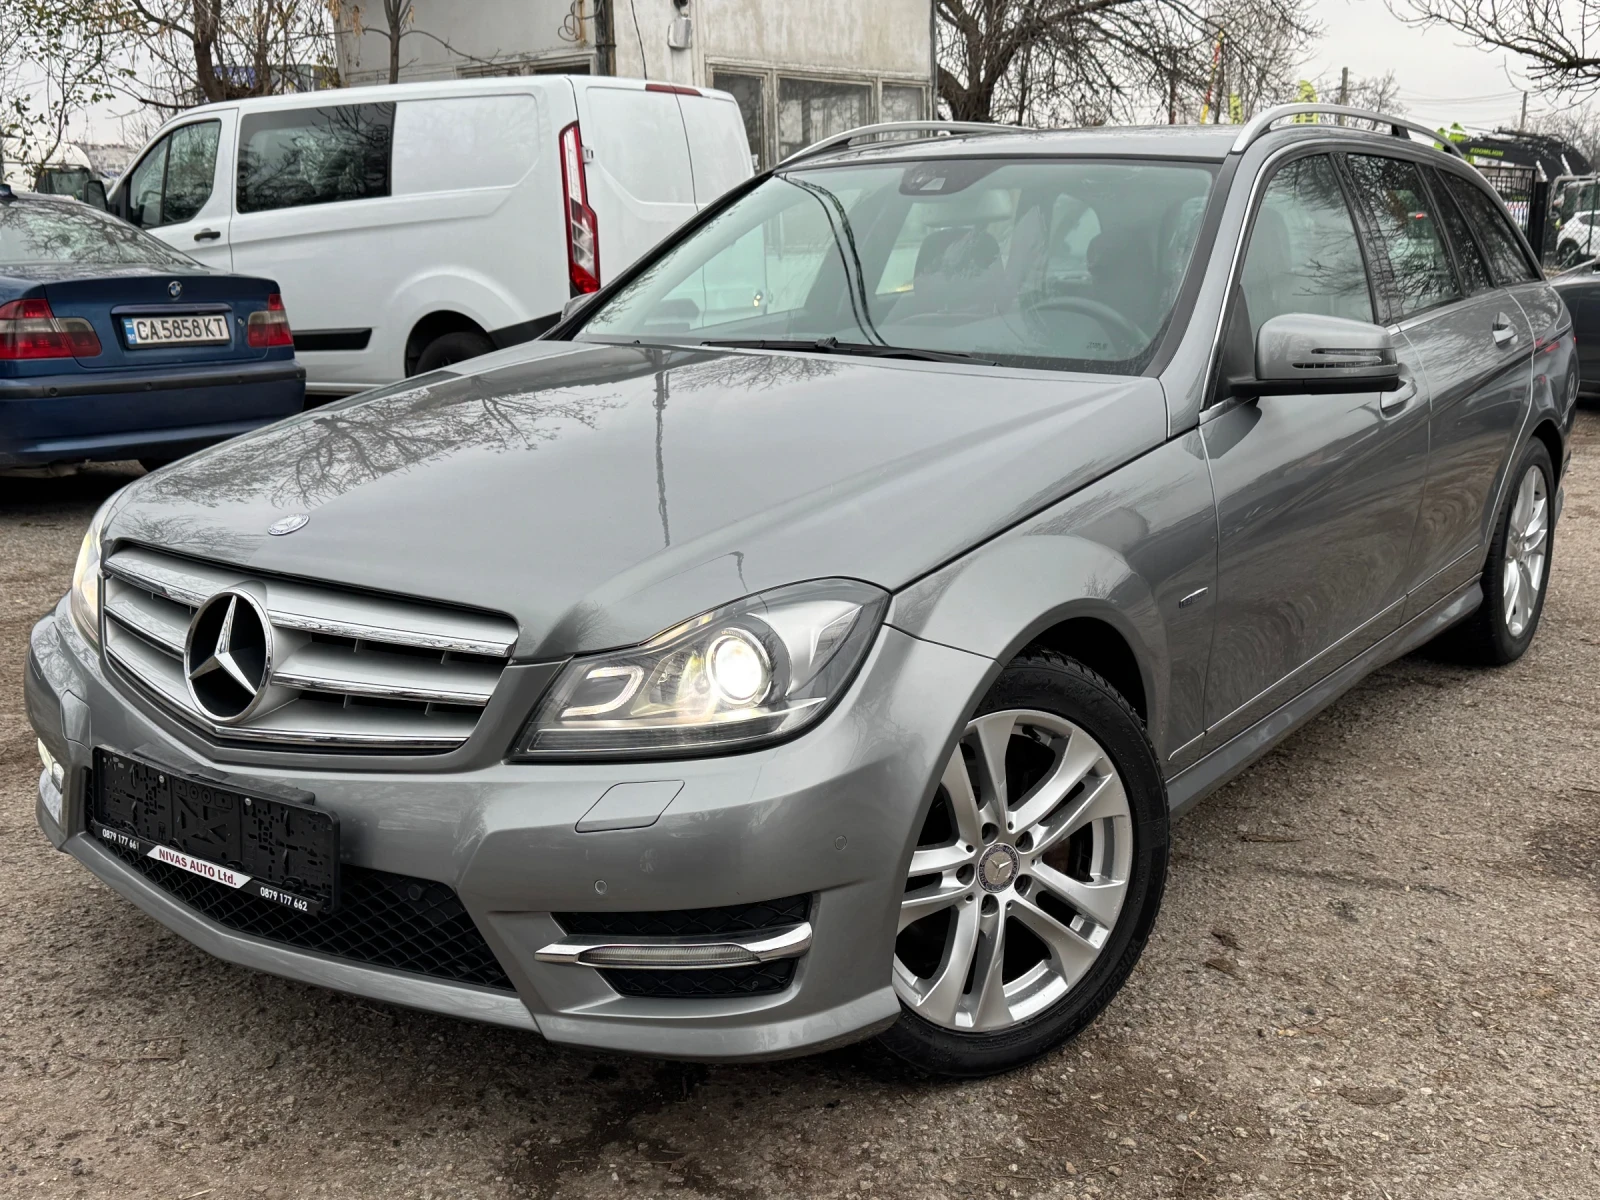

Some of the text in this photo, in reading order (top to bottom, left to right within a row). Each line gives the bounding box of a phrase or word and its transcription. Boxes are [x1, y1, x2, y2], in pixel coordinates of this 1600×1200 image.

[102, 828, 117, 841] 0879
[118, 834, 128, 846] 177
[158, 848, 237, 886] NIVAS AUTO Ltd.
[260, 886, 308, 911] 0879 177 662
